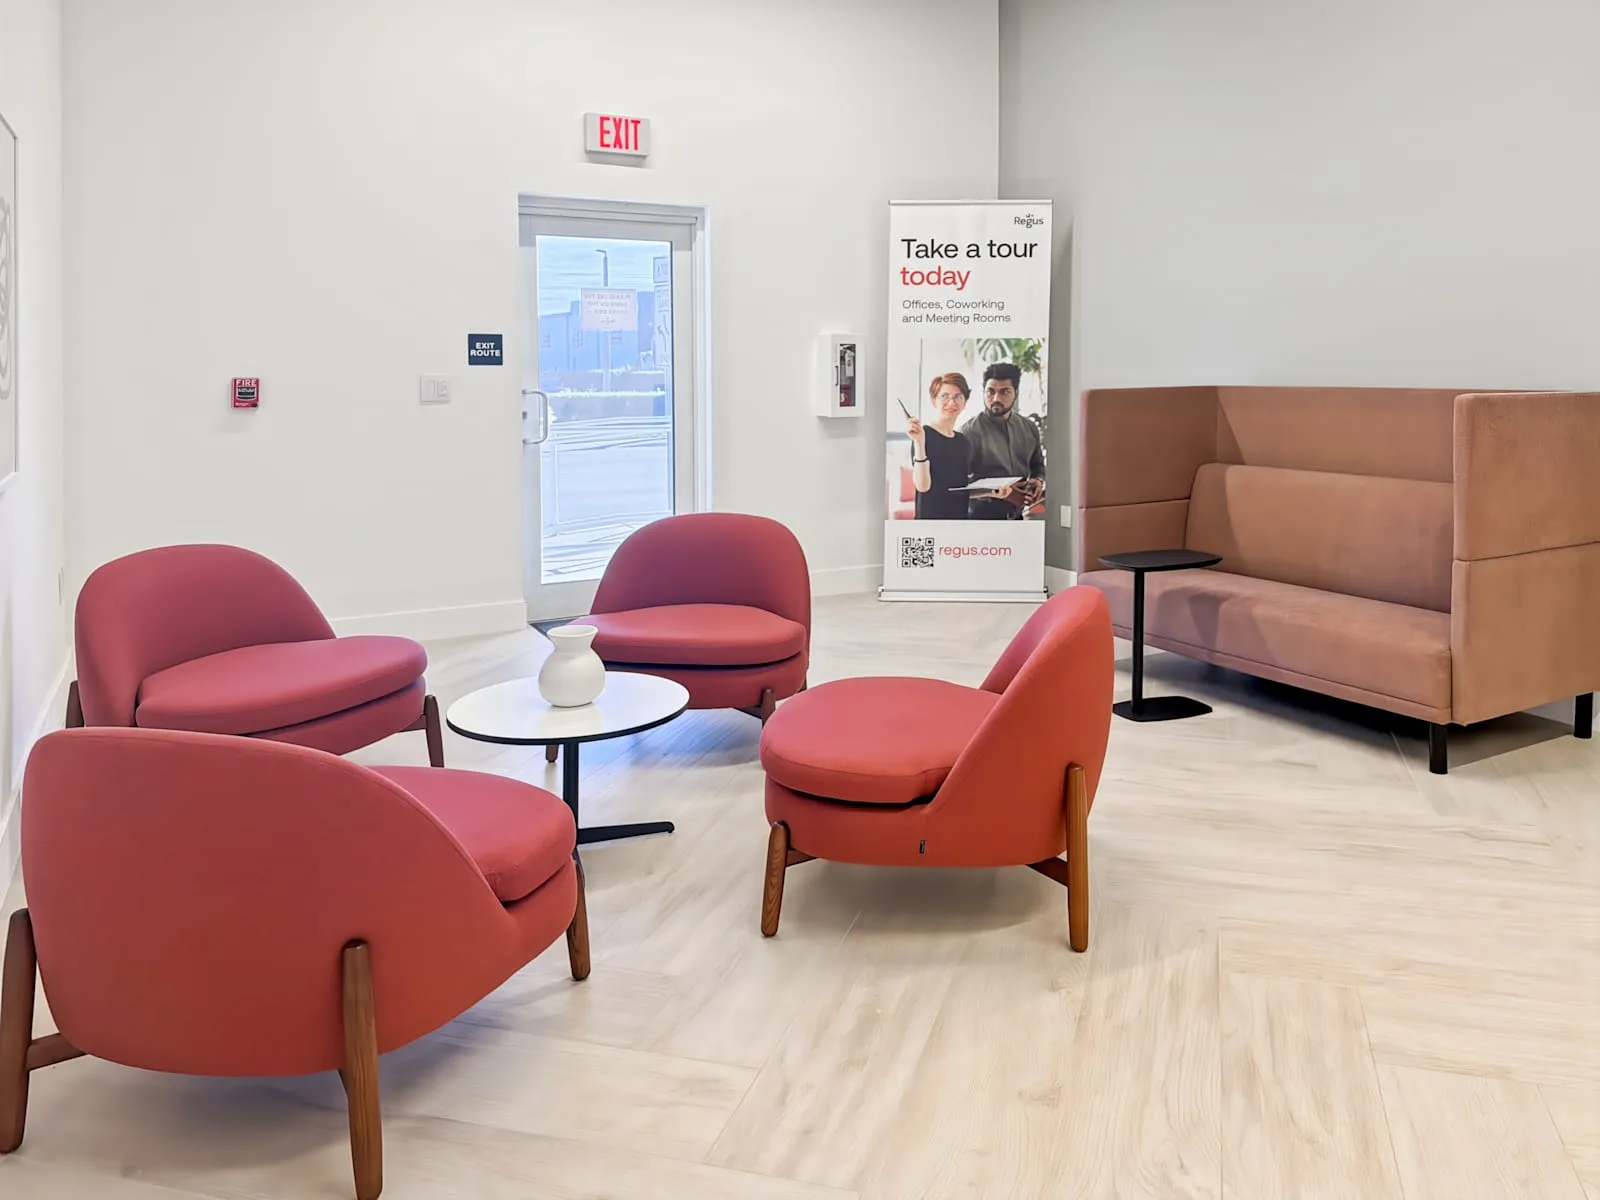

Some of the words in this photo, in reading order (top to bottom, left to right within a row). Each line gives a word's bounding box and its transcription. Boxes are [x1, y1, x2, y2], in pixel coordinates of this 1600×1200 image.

[600, 116, 641, 151] EXIT
[1014, 215, 1044, 229] Regus
[901, 238, 959, 259] Take
[966, 243, 981, 259] a
[987, 239, 1038, 258] tour
[900, 265, 971, 291] today
[902, 299, 944, 310] Offices,
[946, 299, 1005, 311] Coworking
[902, 313, 923, 323] and
[926, 313, 970, 325] Meeting
[973, 313, 1011, 323] Rooms
[470, 349, 501, 357] ROUTE
[938, 545, 1012, 559] regus.com
